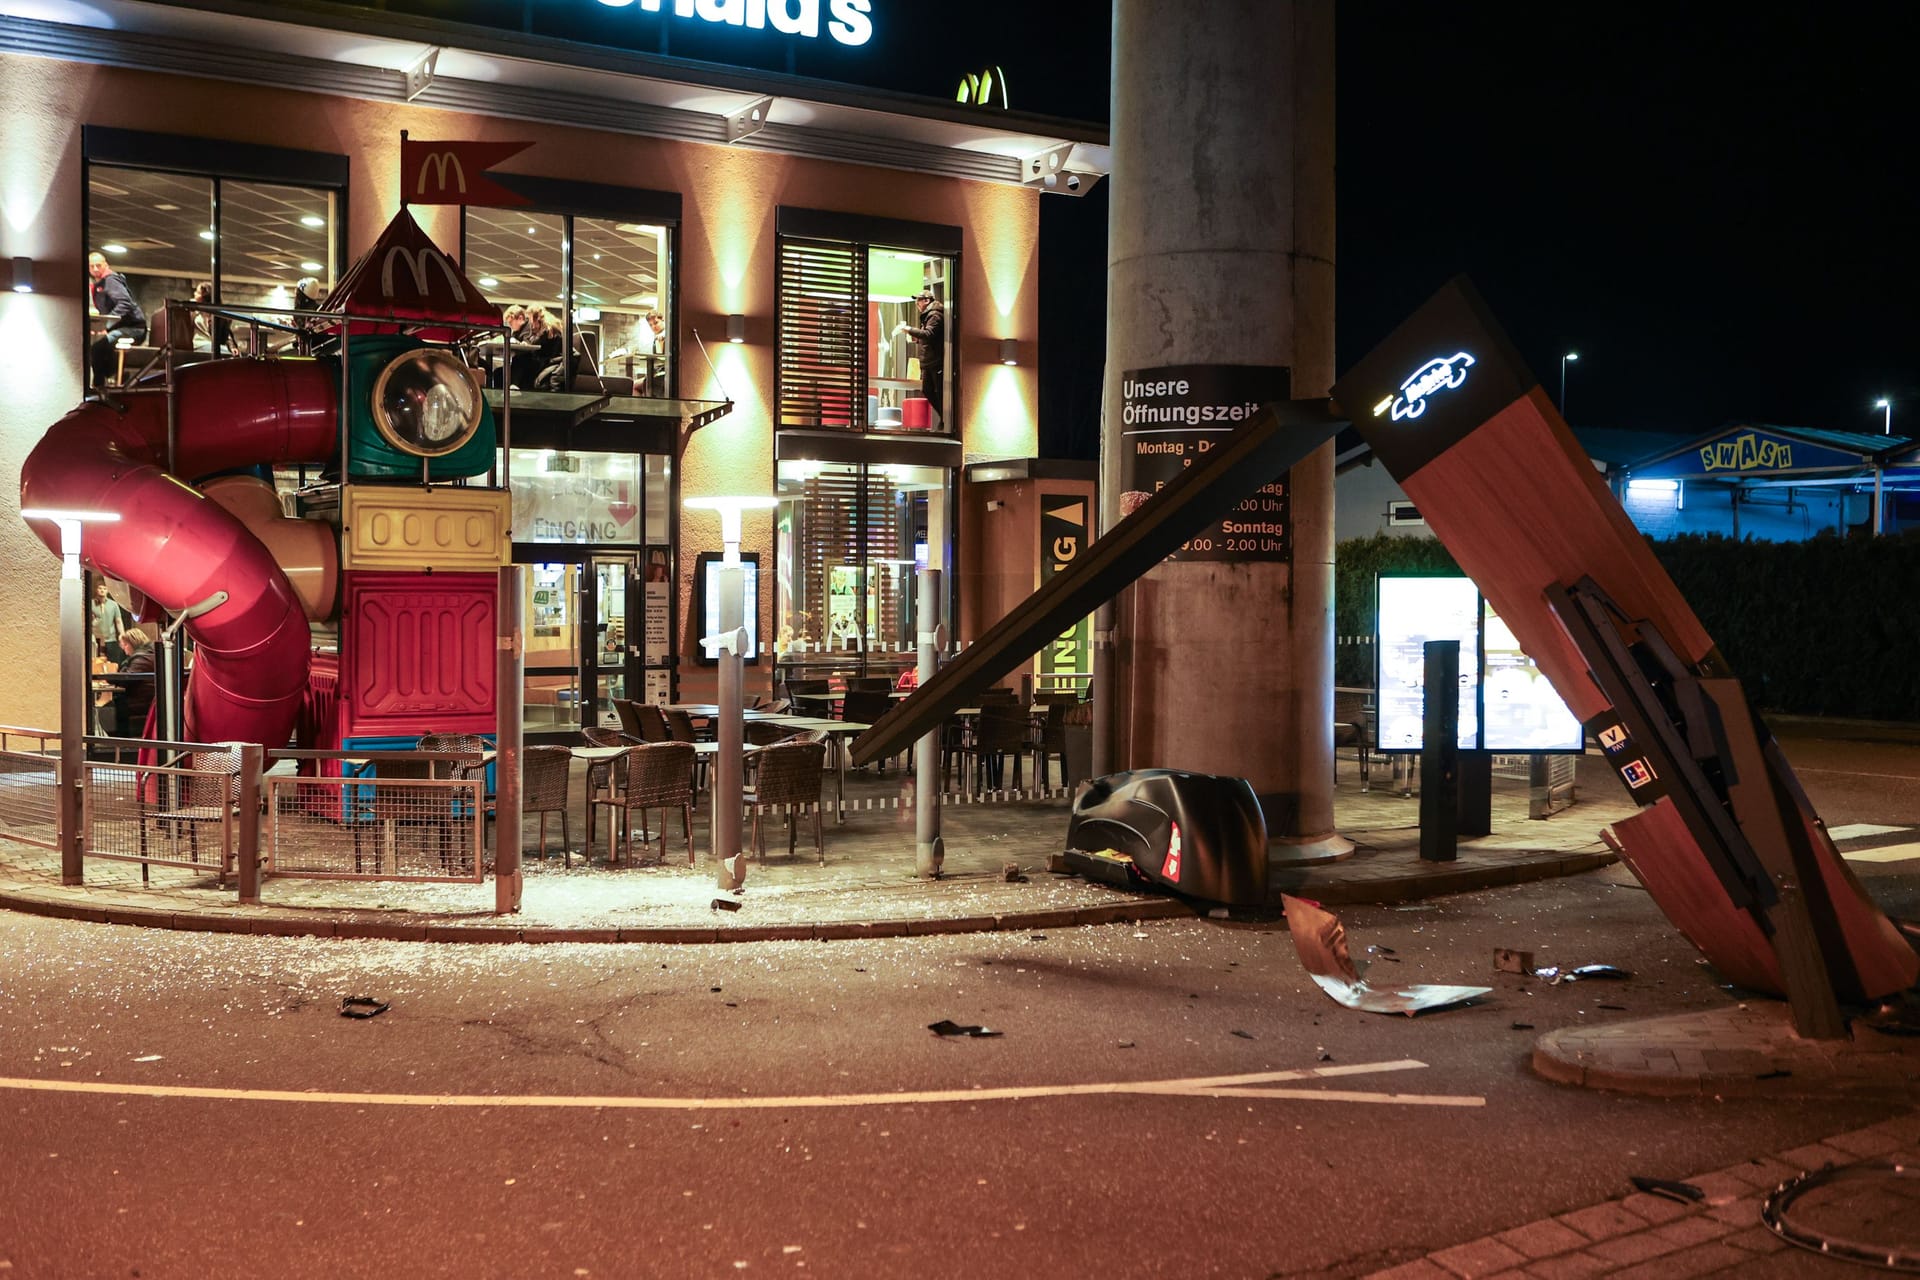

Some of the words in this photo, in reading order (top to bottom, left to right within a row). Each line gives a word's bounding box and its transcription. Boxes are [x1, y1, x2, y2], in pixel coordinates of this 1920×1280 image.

[1123, 380, 1190, 399] Unsere
[1122, 402, 1260, 425] Öffnungszeit
[1137, 442, 1184, 455] Montag
[1198, 440, 1217, 453] D
[1702, 437, 1791, 469] SWASH
[1232, 500, 1258, 511] .00
[1261, 500, 1283, 512] Uhr
[1222, 520, 1283, 537] Sonntag
[1226, 539, 1257, 551] 2.00
[1260, 539, 1282, 552] Uhr
